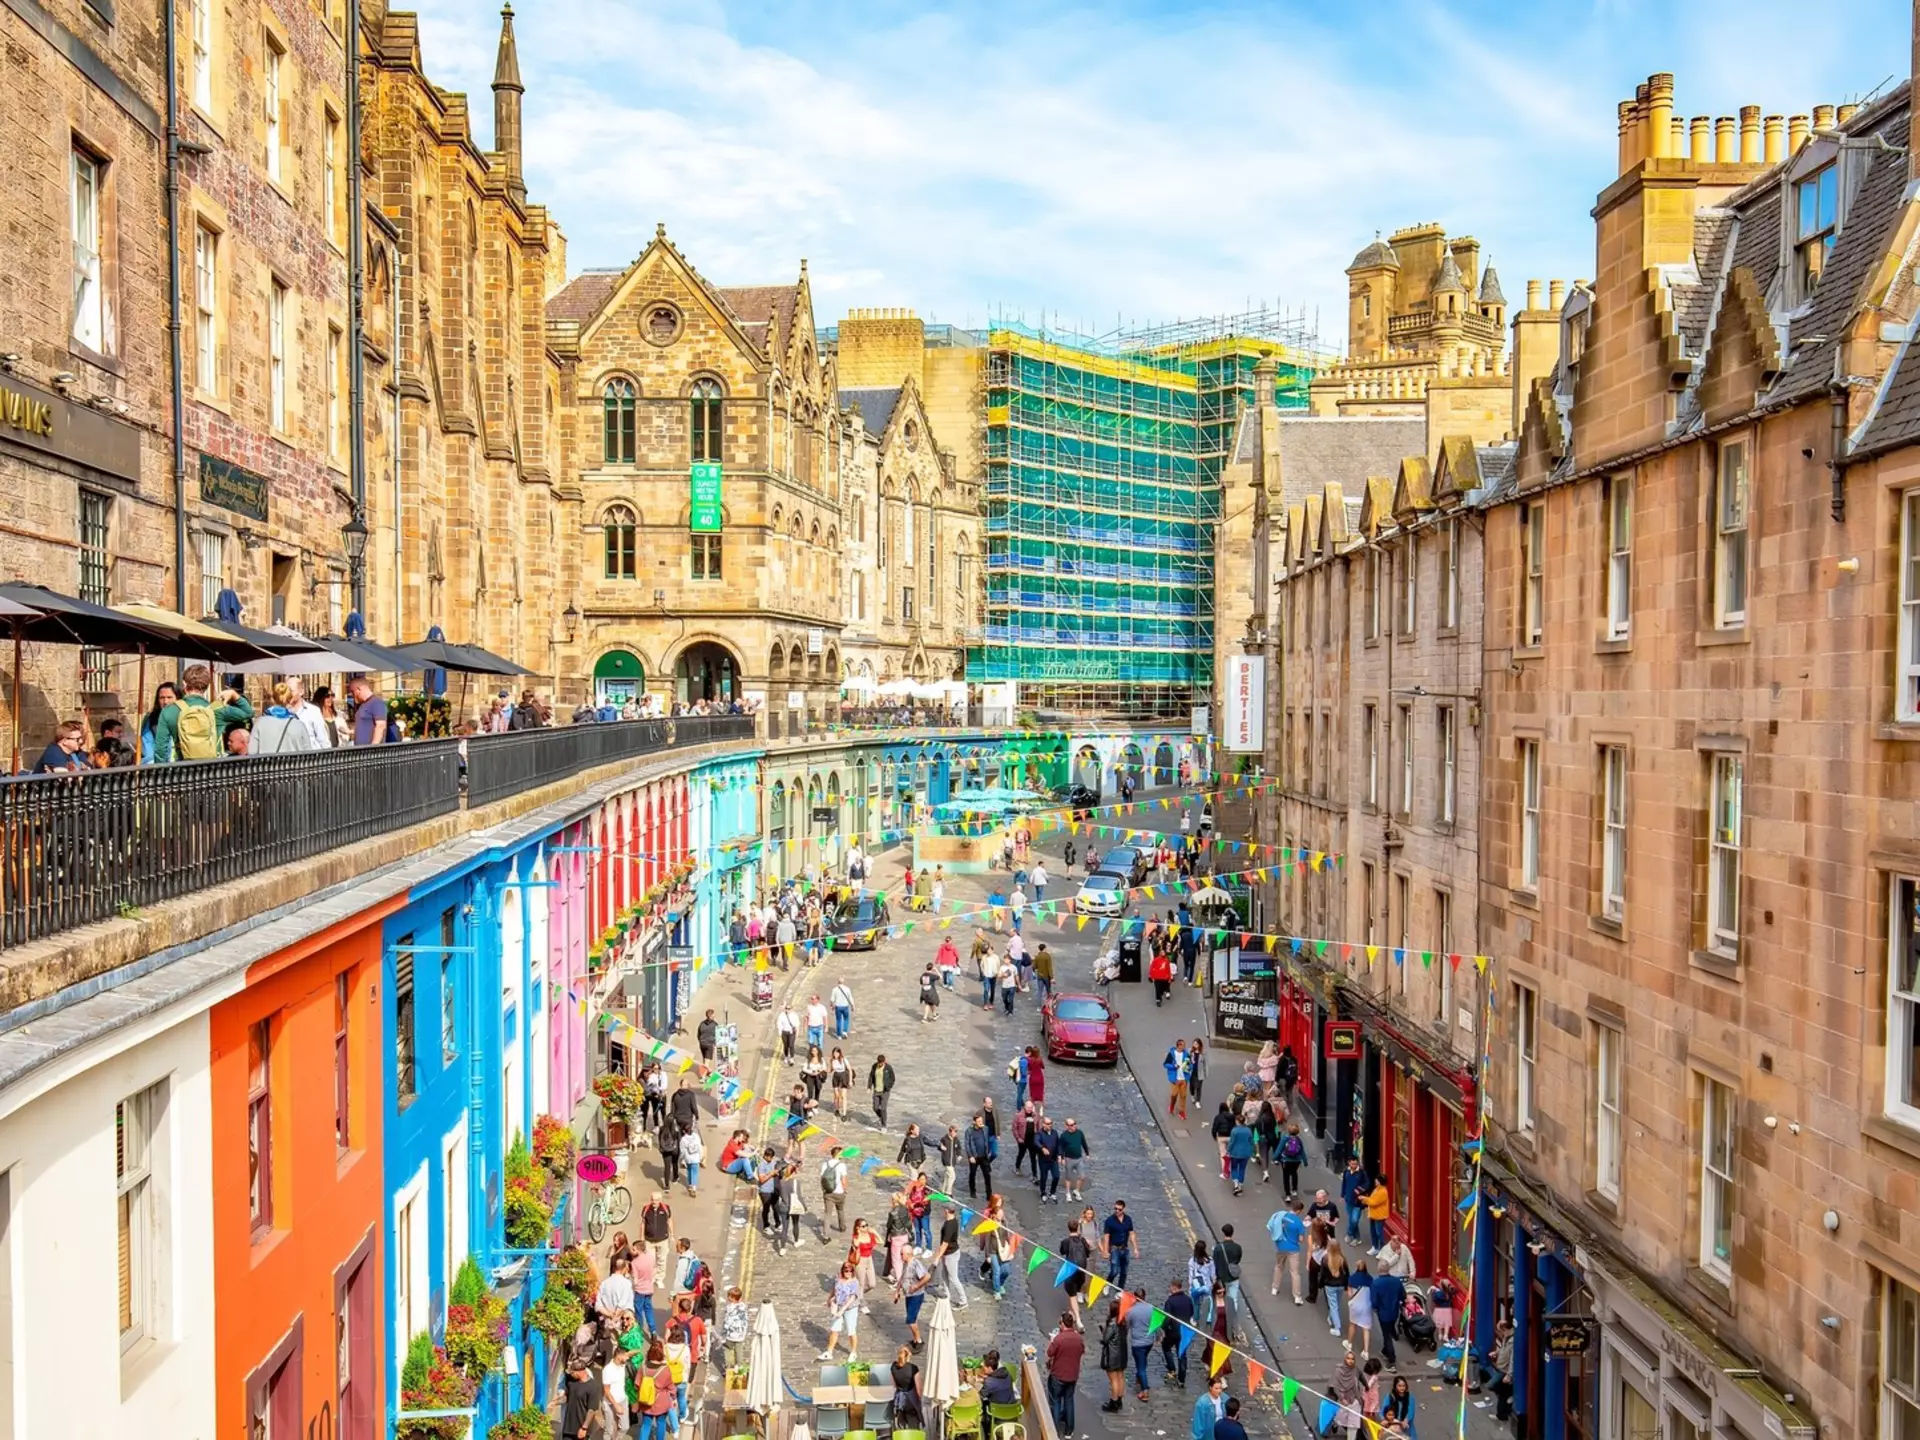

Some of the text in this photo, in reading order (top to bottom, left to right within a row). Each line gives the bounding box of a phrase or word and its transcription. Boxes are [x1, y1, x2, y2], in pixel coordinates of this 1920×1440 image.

[701, 515, 712, 525] 40
[1240, 662, 1249, 744] BERTIES
[1220, 1001, 1263, 1017] BEER GARDE
[1224, 1017, 1243, 1030] OPEN
